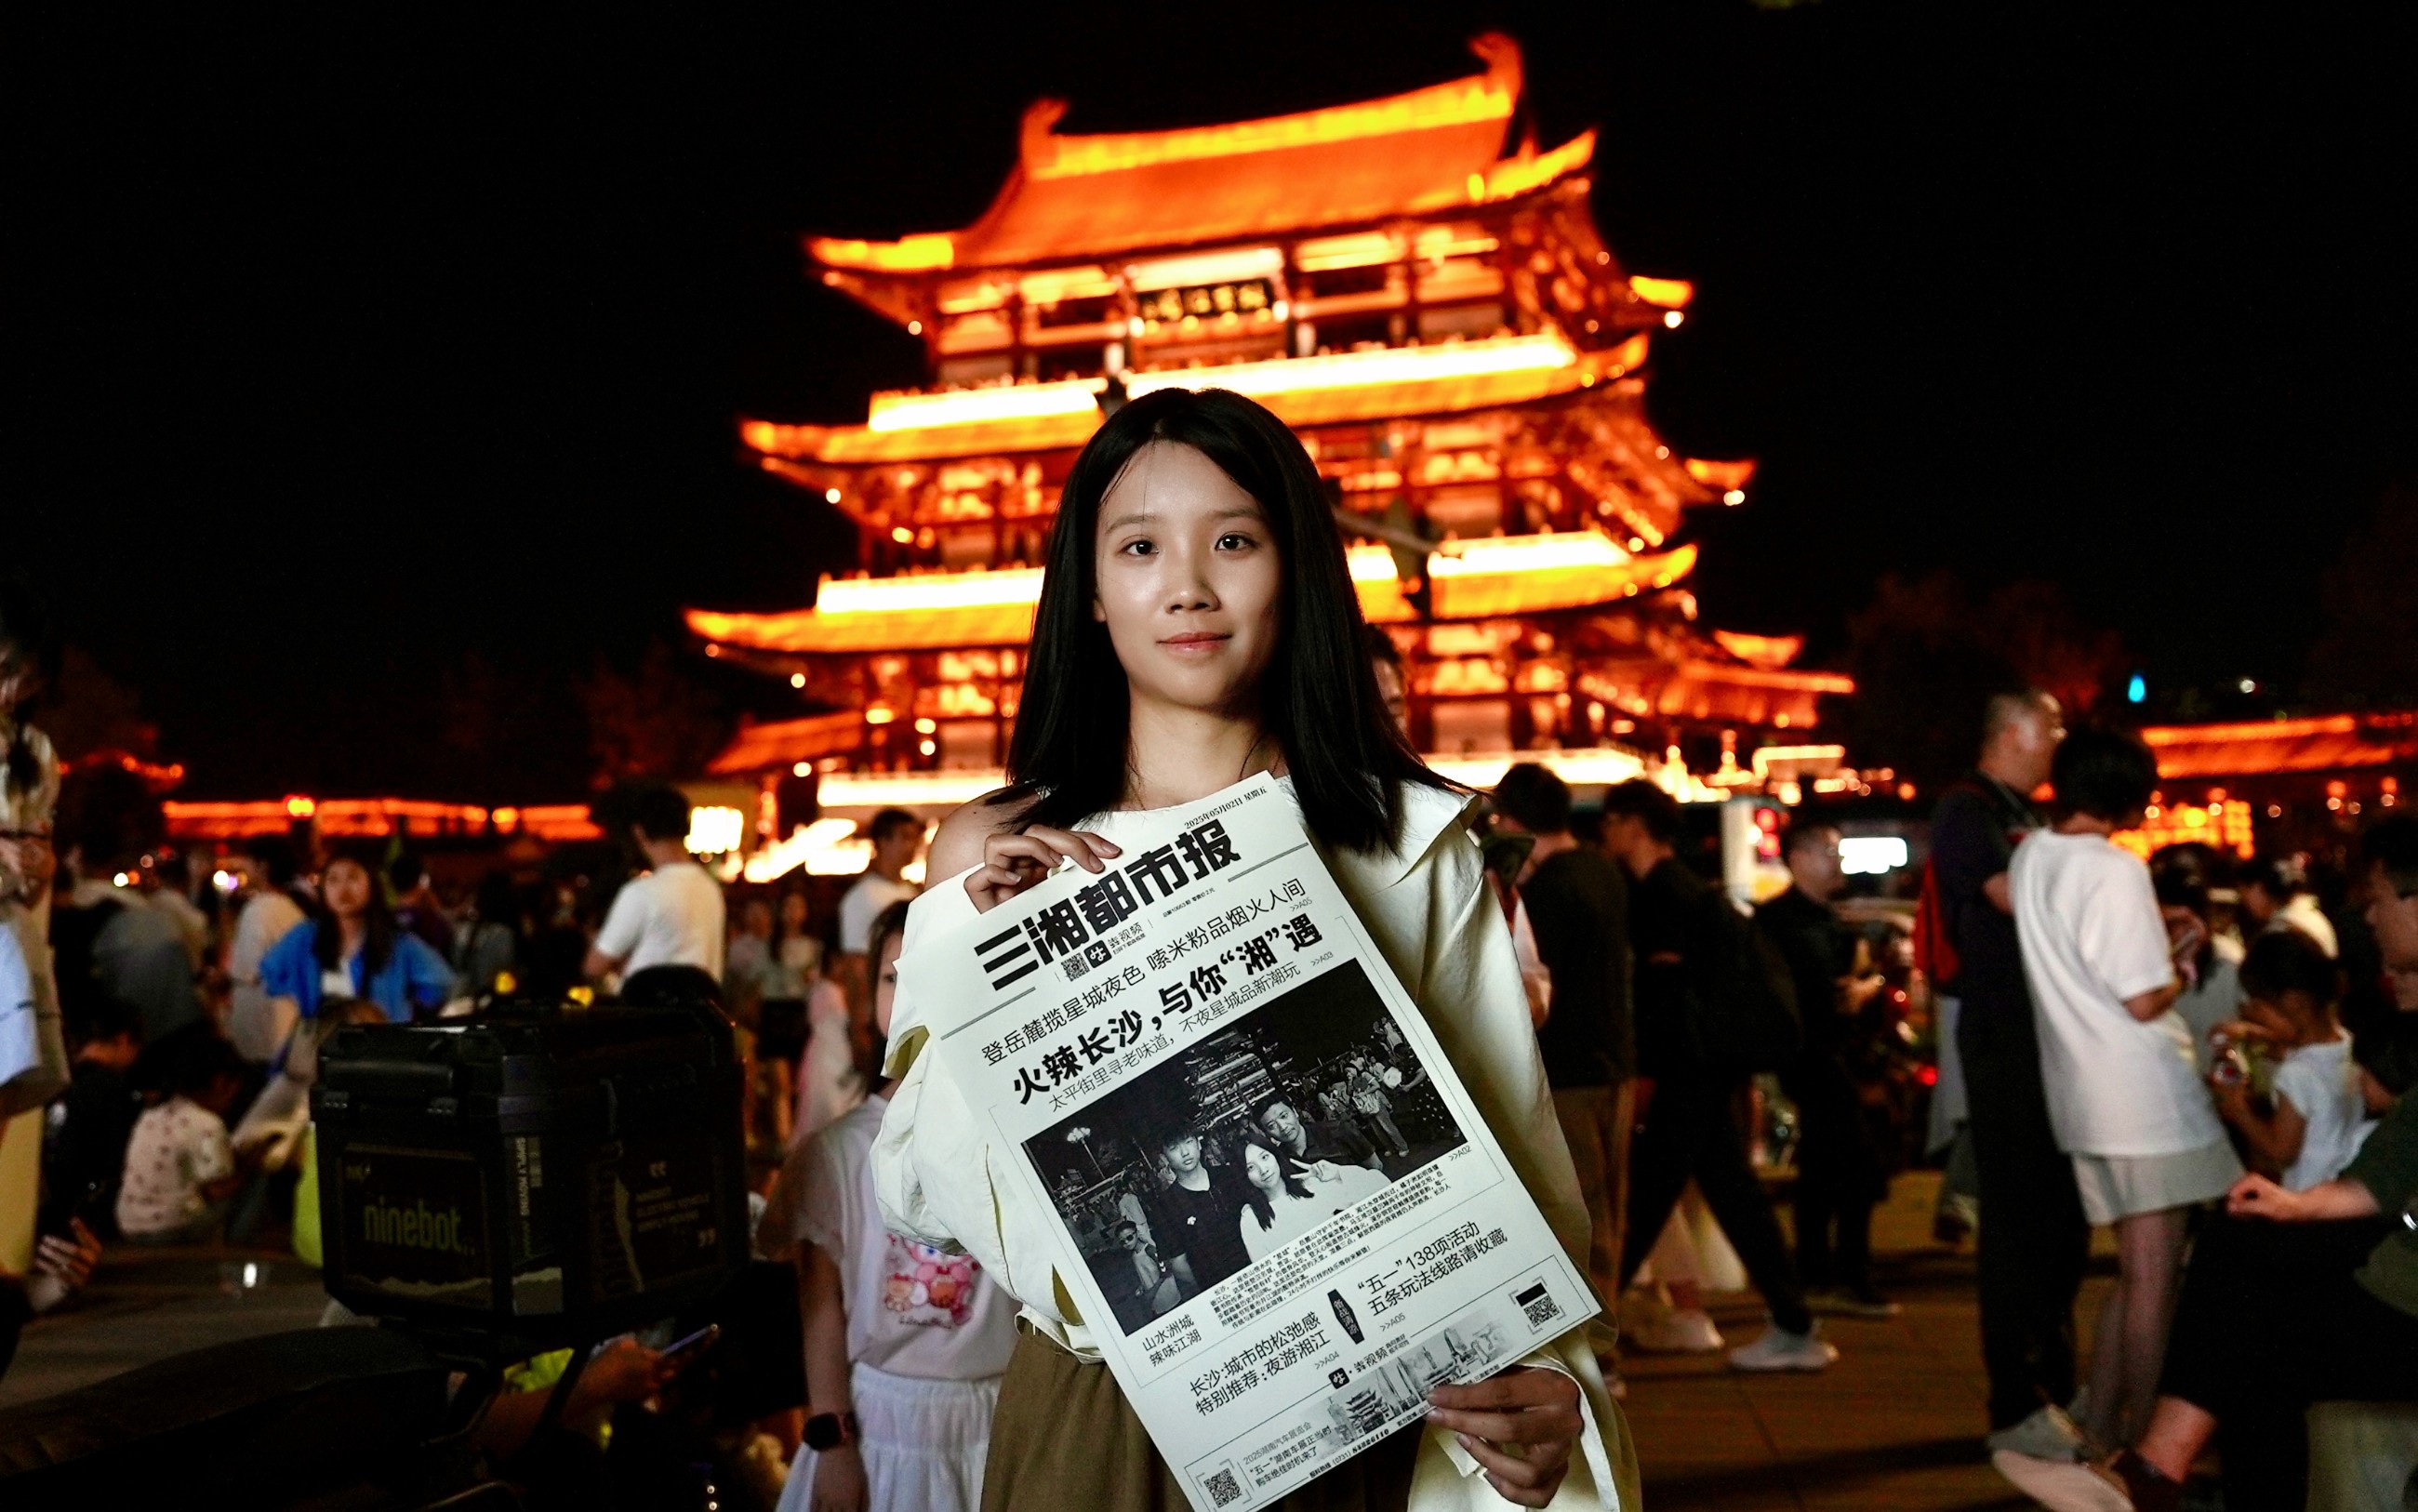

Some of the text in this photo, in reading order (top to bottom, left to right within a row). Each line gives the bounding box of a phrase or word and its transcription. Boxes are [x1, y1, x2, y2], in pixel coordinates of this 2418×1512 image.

[973, 817, 1242, 991] 三湘都市报
[981, 877, 1306, 1066] 登岳麓揽星城夜色 嗦米粉品烟火人间
[363, 1194, 462, 1253] ninebot
[1357, 1220, 1480, 1294] “五一”138项活动
[1367, 1227, 1508, 1316] 五条玩法线路请收藏
[1142, 1313, 1194, 1351] 山水洲城
[1149, 1328, 1202, 1367] 辣味江湖
